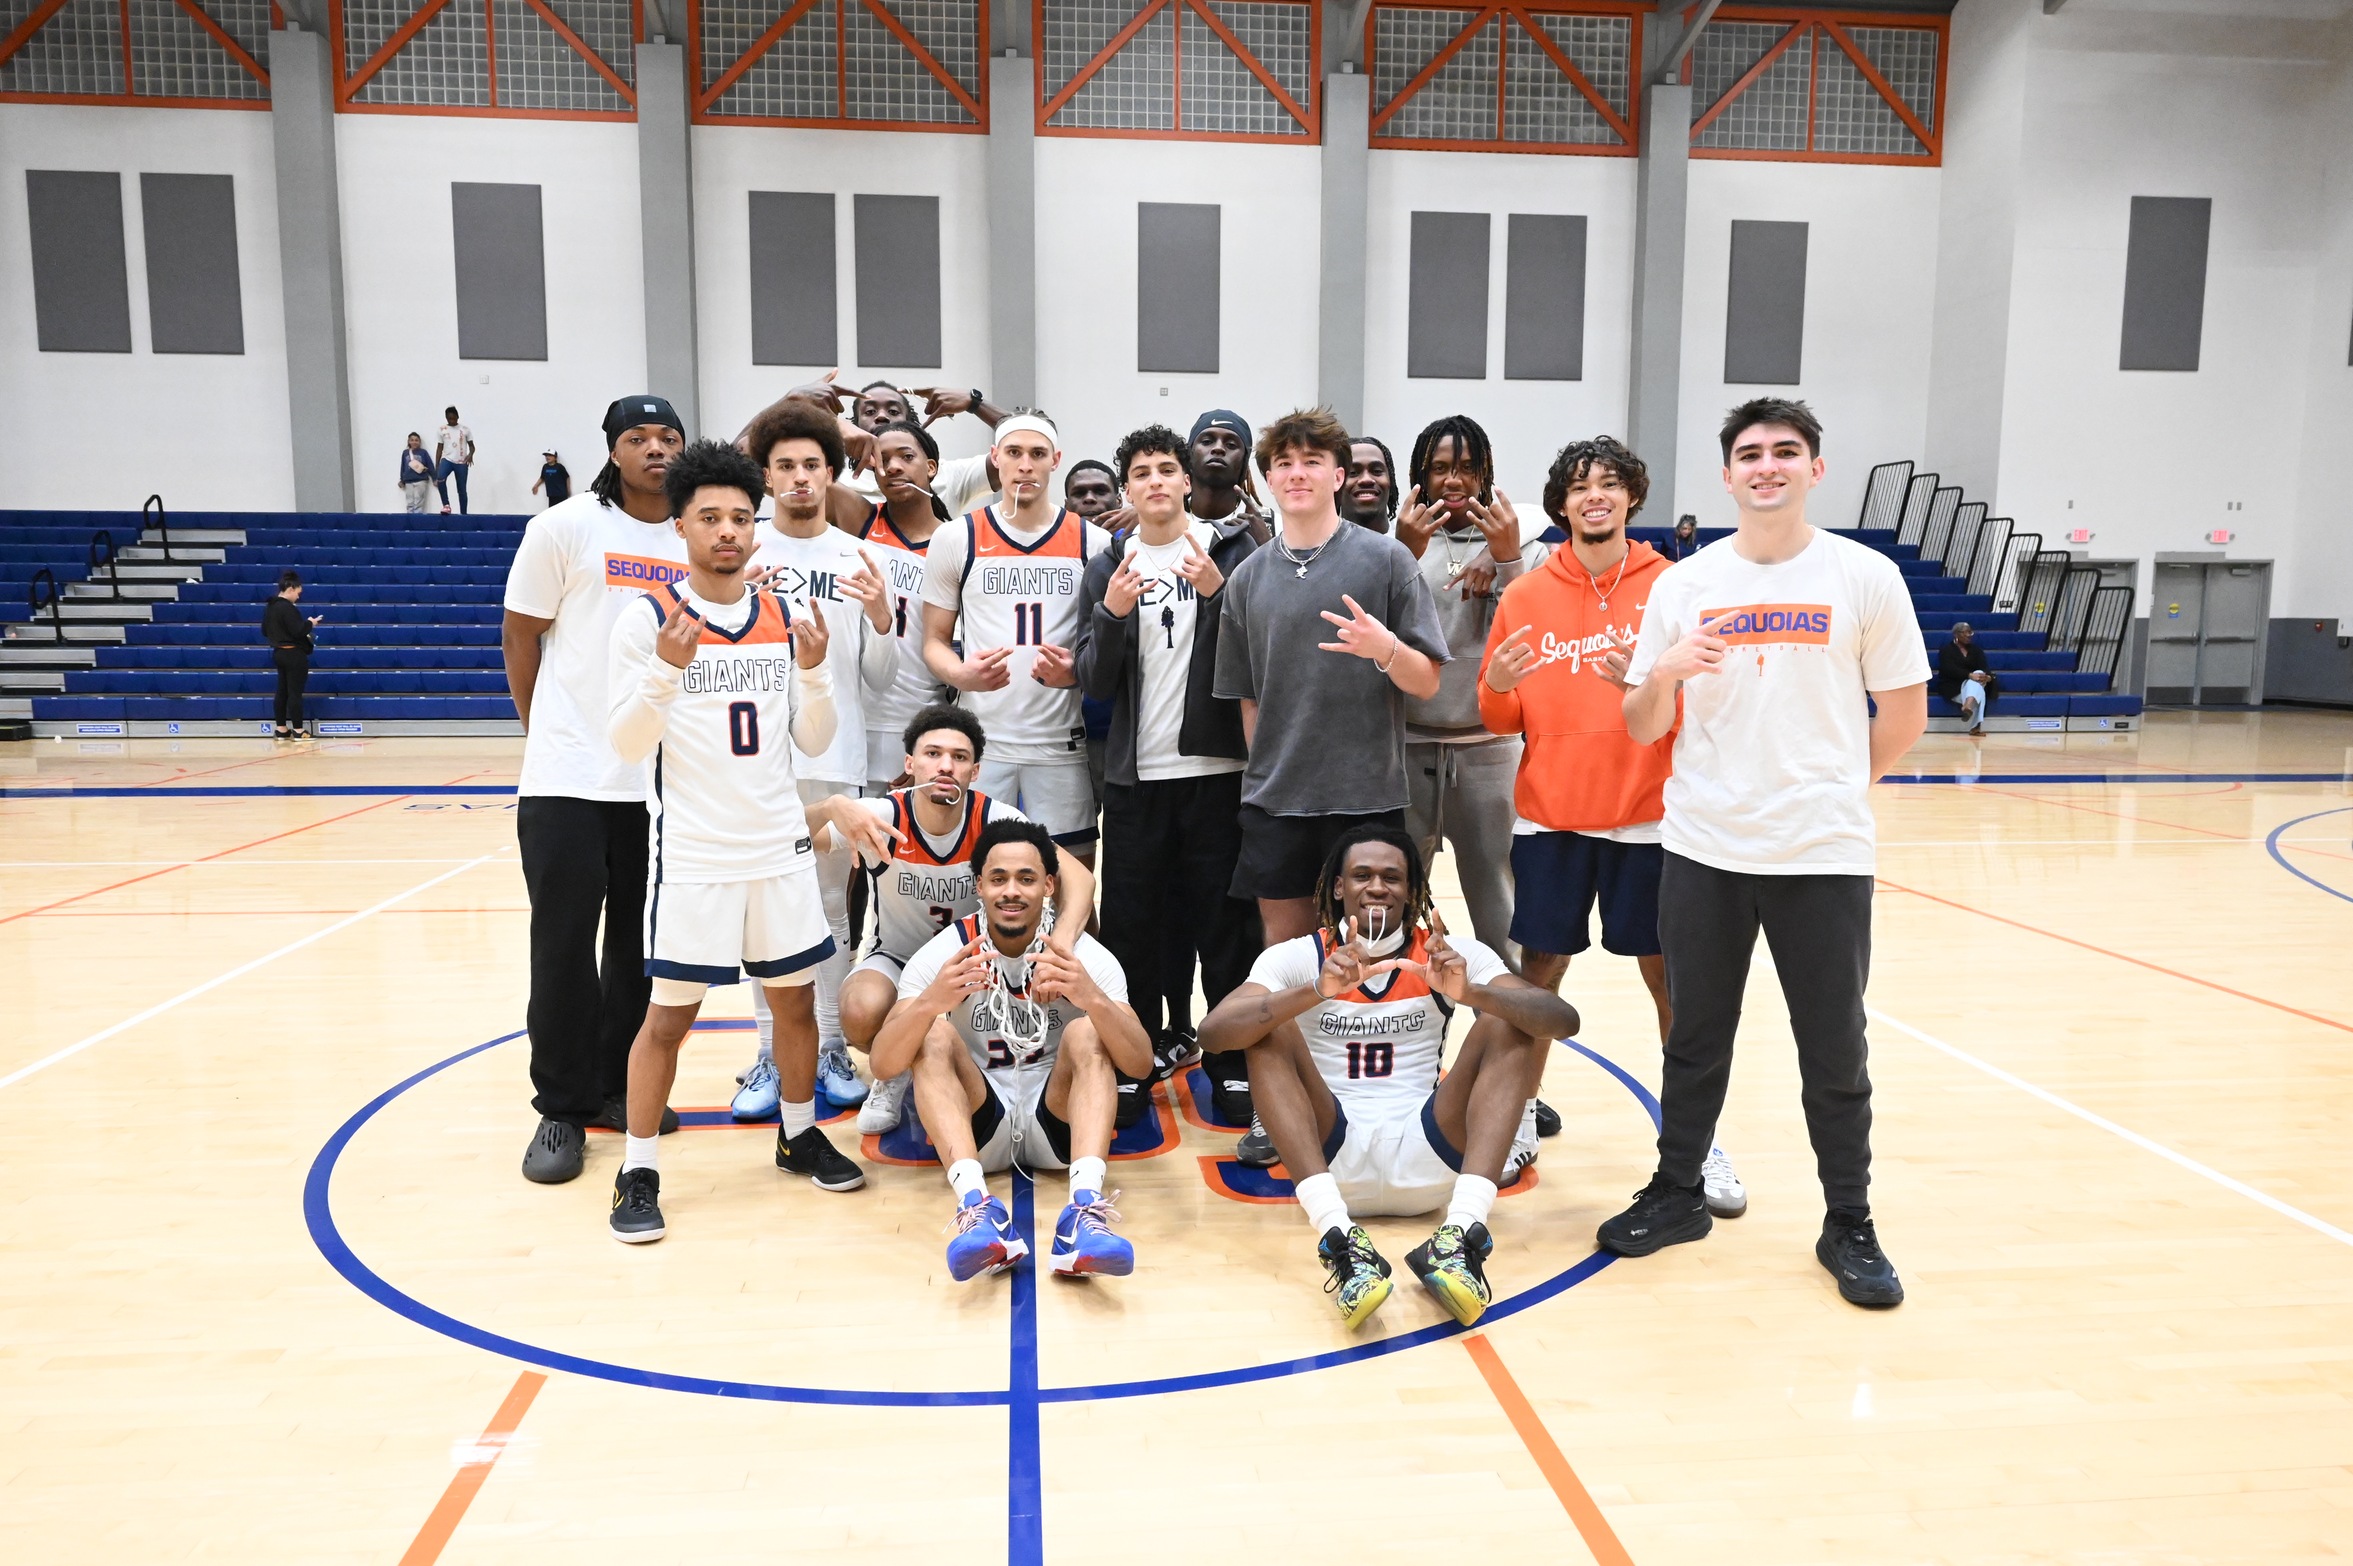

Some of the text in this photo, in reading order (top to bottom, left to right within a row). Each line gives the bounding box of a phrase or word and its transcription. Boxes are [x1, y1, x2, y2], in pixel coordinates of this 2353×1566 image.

[607, 559, 690, 583] SEQUOIA
[983, 567, 1073, 595] GIANTS
[1139, 574, 1194, 607] E>M
[1014, 602, 1042, 646] 11
[683, 659, 786, 693] GIANTS
[728, 701, 760, 756] 0
[1346, 1042, 1394, 1079] 10
